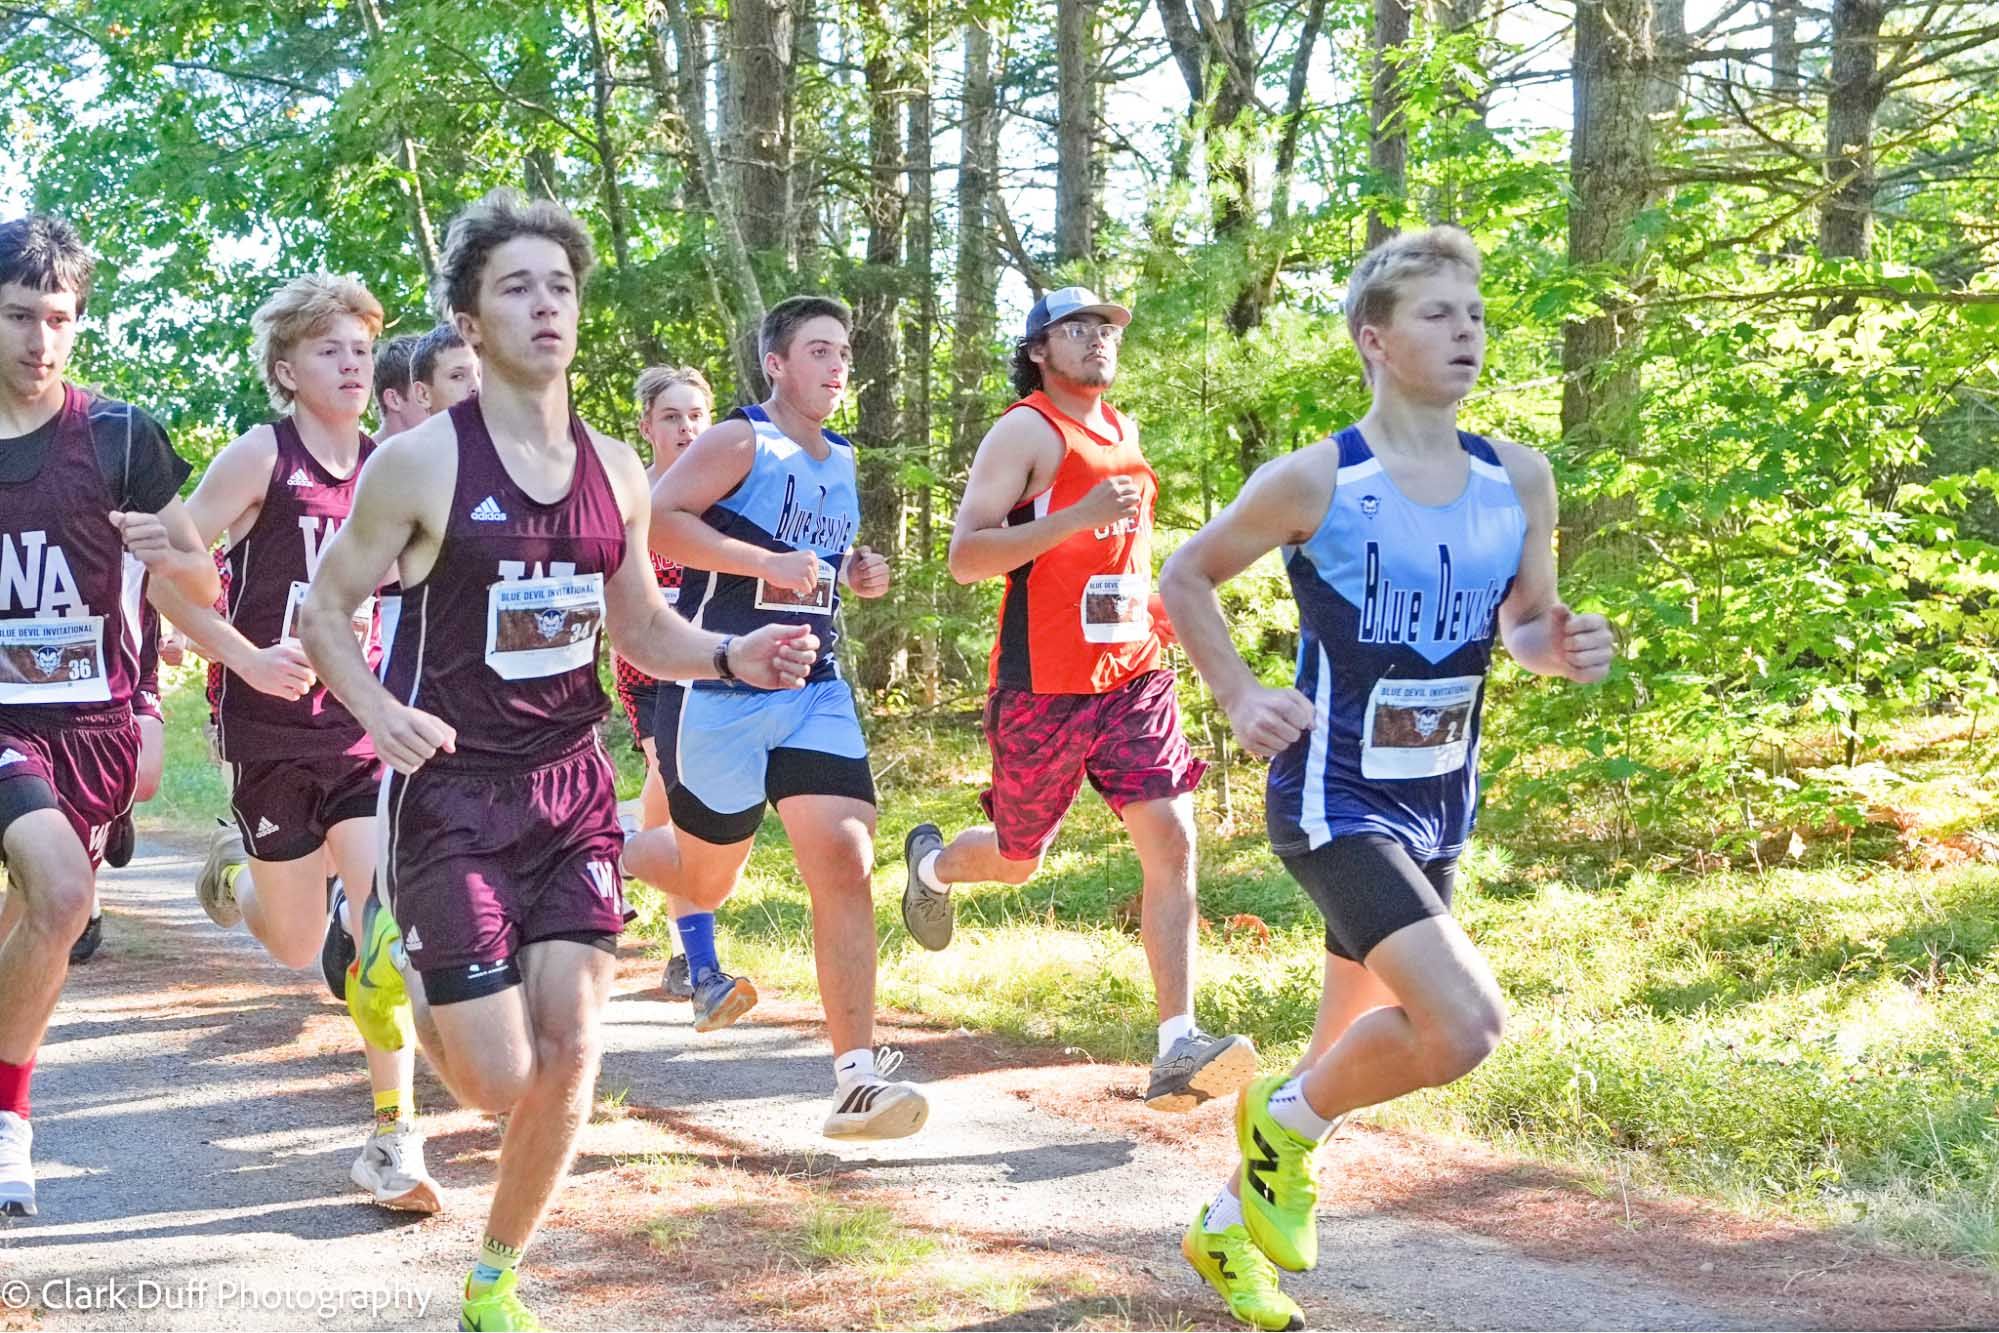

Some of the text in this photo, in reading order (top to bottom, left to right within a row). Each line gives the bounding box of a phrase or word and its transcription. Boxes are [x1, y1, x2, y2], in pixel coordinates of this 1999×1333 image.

[470, 511, 507, 521] adidas
[501, 591, 521, 602] BLUE
[524, 590, 545, 599] DEVIL
[19, 627, 40, 637] DEVIL
[43, 624, 92, 636] INVITATIONAL
[570, 620, 592, 643] 34
[68, 657, 92, 680] 36
[1381, 687, 1401, 697] BLUE
[1404, 687, 1425, 697] DEVIL
[1445, 721, 1457, 743] 2
